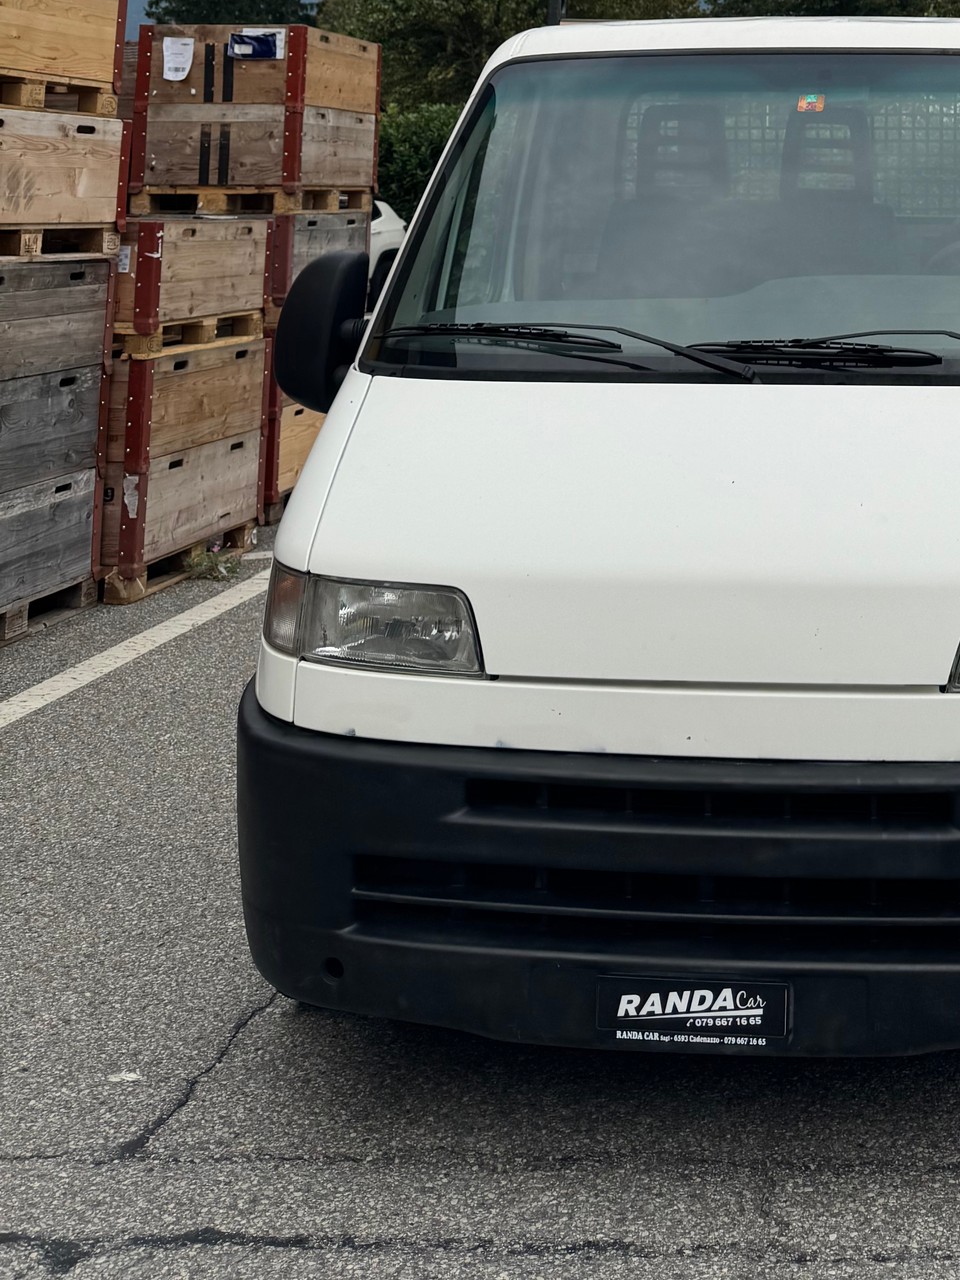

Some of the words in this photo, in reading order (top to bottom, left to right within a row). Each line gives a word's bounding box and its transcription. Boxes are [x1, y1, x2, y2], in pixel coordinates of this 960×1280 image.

[617, 988, 735, 1017] RANDA
[735, 990, 766, 1009] Car
[695, 1019, 714, 1027] 079
[715, 1018, 733, 1026] 667
[736, 1018, 747, 1026] 16
[749, 1017, 762, 1025] 65
[616, 1030, 643, 1040] RANDA
[644, 1032, 659, 1041] CAR
[689, 1035, 719, 1044] Cadenazzo
[736, 1037, 748, 1045] 667
